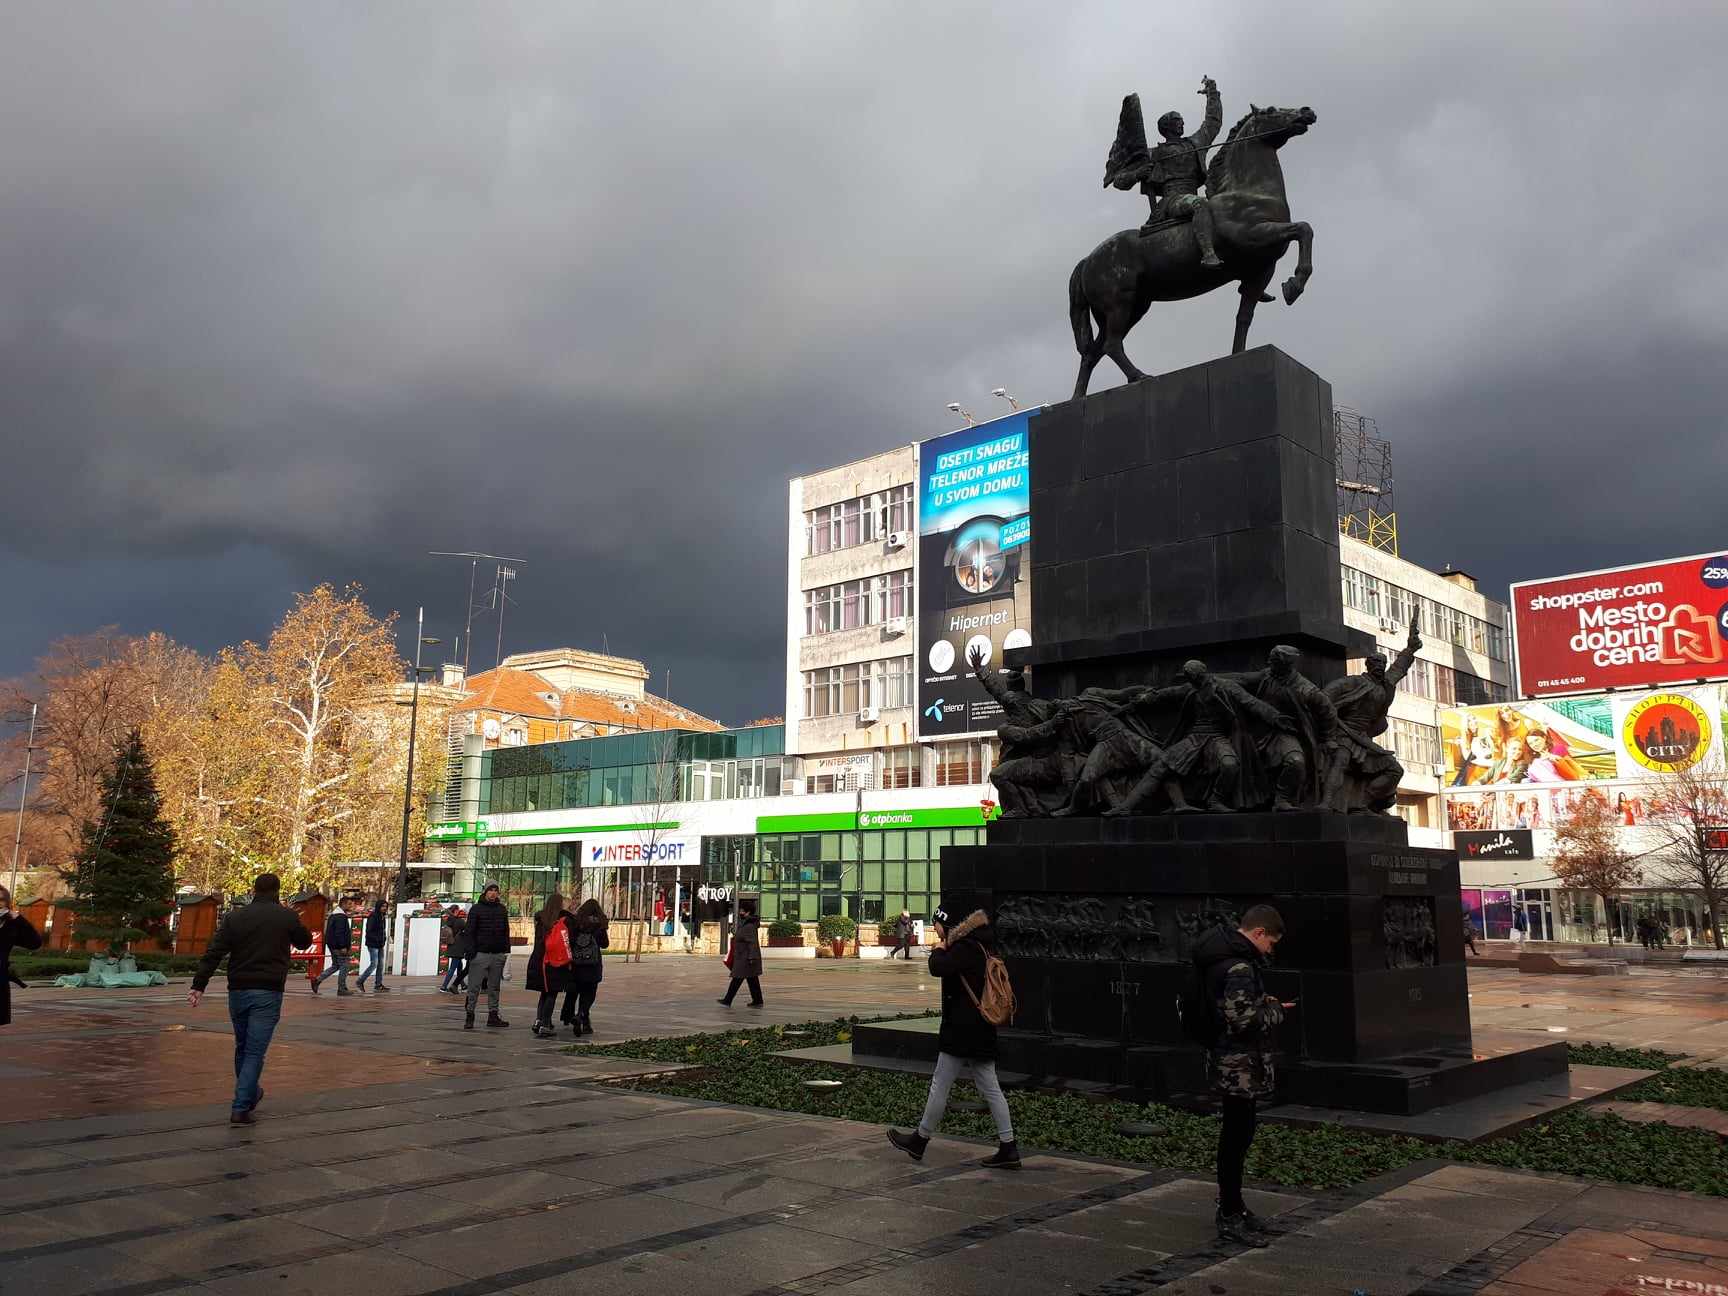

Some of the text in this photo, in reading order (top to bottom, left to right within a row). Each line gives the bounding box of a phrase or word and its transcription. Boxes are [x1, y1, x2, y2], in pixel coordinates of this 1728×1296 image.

[940, 437, 1020, 469] OSETI SNAGU
[930, 452, 1029, 490] TELENOR MREŽE
[934, 474, 1024, 506] U SVOM DOMU.
[1530, 581, 1664, 610] shoppster.com
[950, 609, 1008, 632] Hipernet
[1579, 600, 1666, 629] Mesto
[1570, 622, 1659, 652] dobrih
[1593, 642, 1660, 667] cena
[825, 755, 870, 767] INTERSPORT
[1646, 744, 1689, 757] CITY
[871, 811, 912, 826] otpbanka
[604, 843, 685, 861] INTERSPORT
